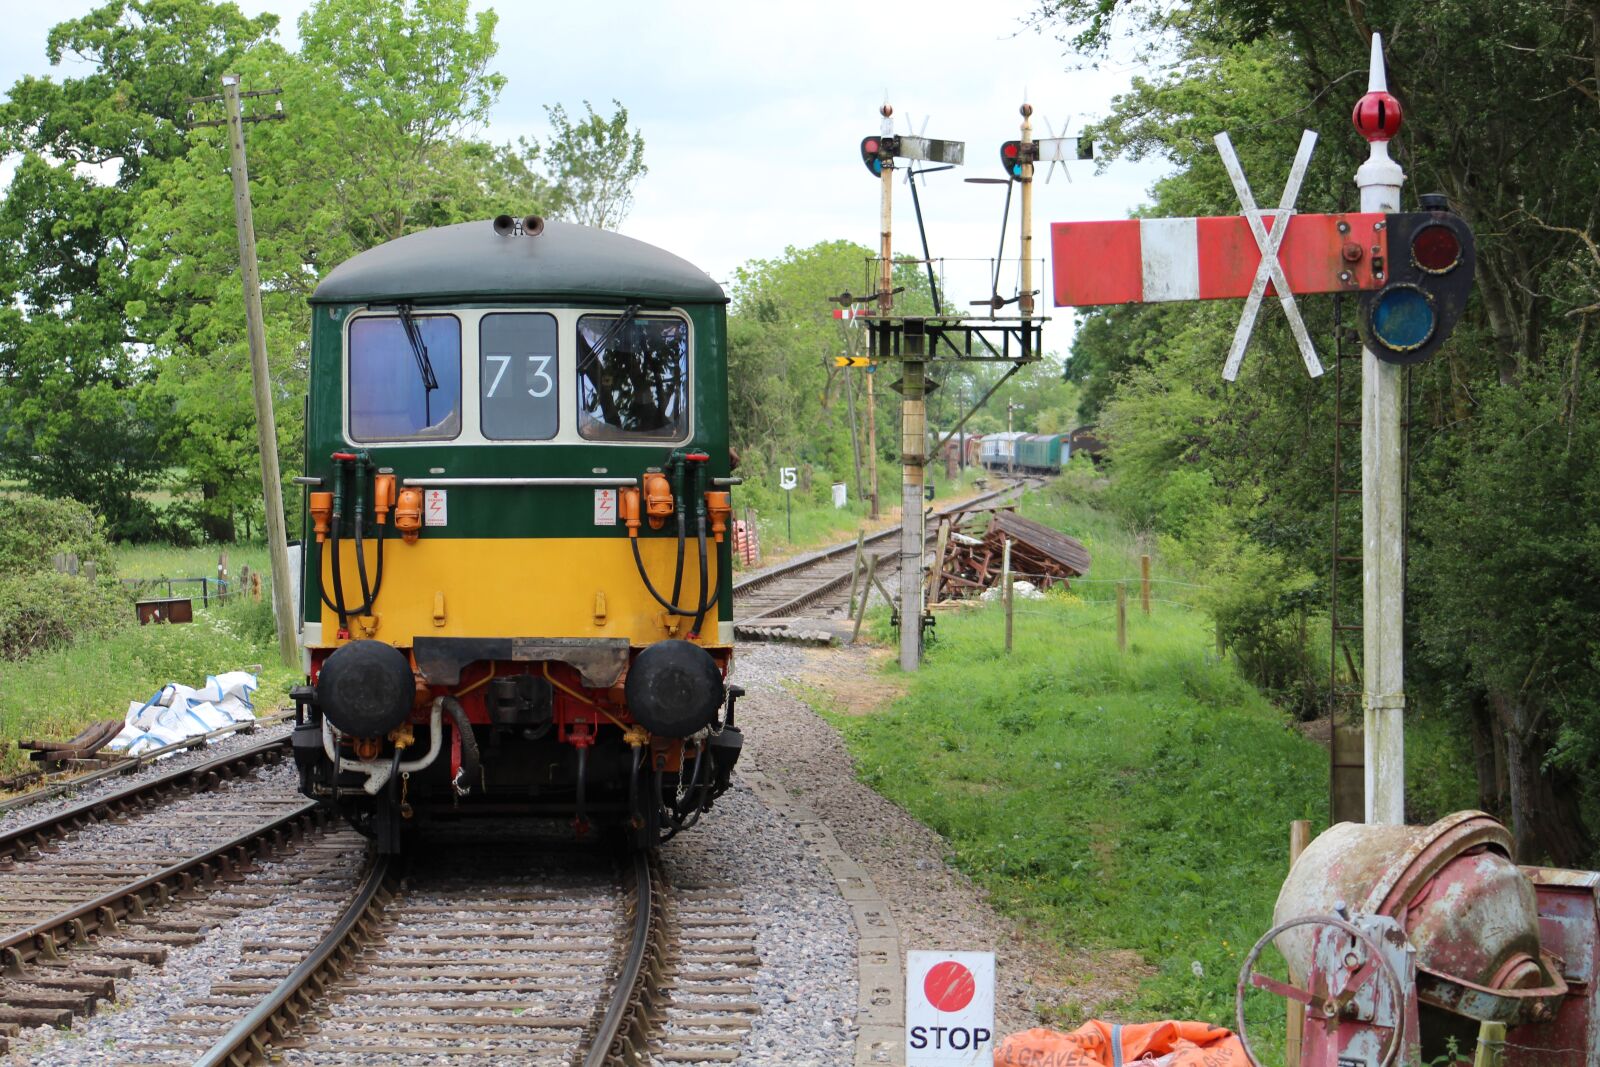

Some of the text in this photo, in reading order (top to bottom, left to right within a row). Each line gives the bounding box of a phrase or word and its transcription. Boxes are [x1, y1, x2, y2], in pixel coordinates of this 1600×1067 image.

[780, 467, 797, 485] 15
[910, 1026, 991, 1051] STOP
[1018, 1046, 1090, 1067] GRAVEL
